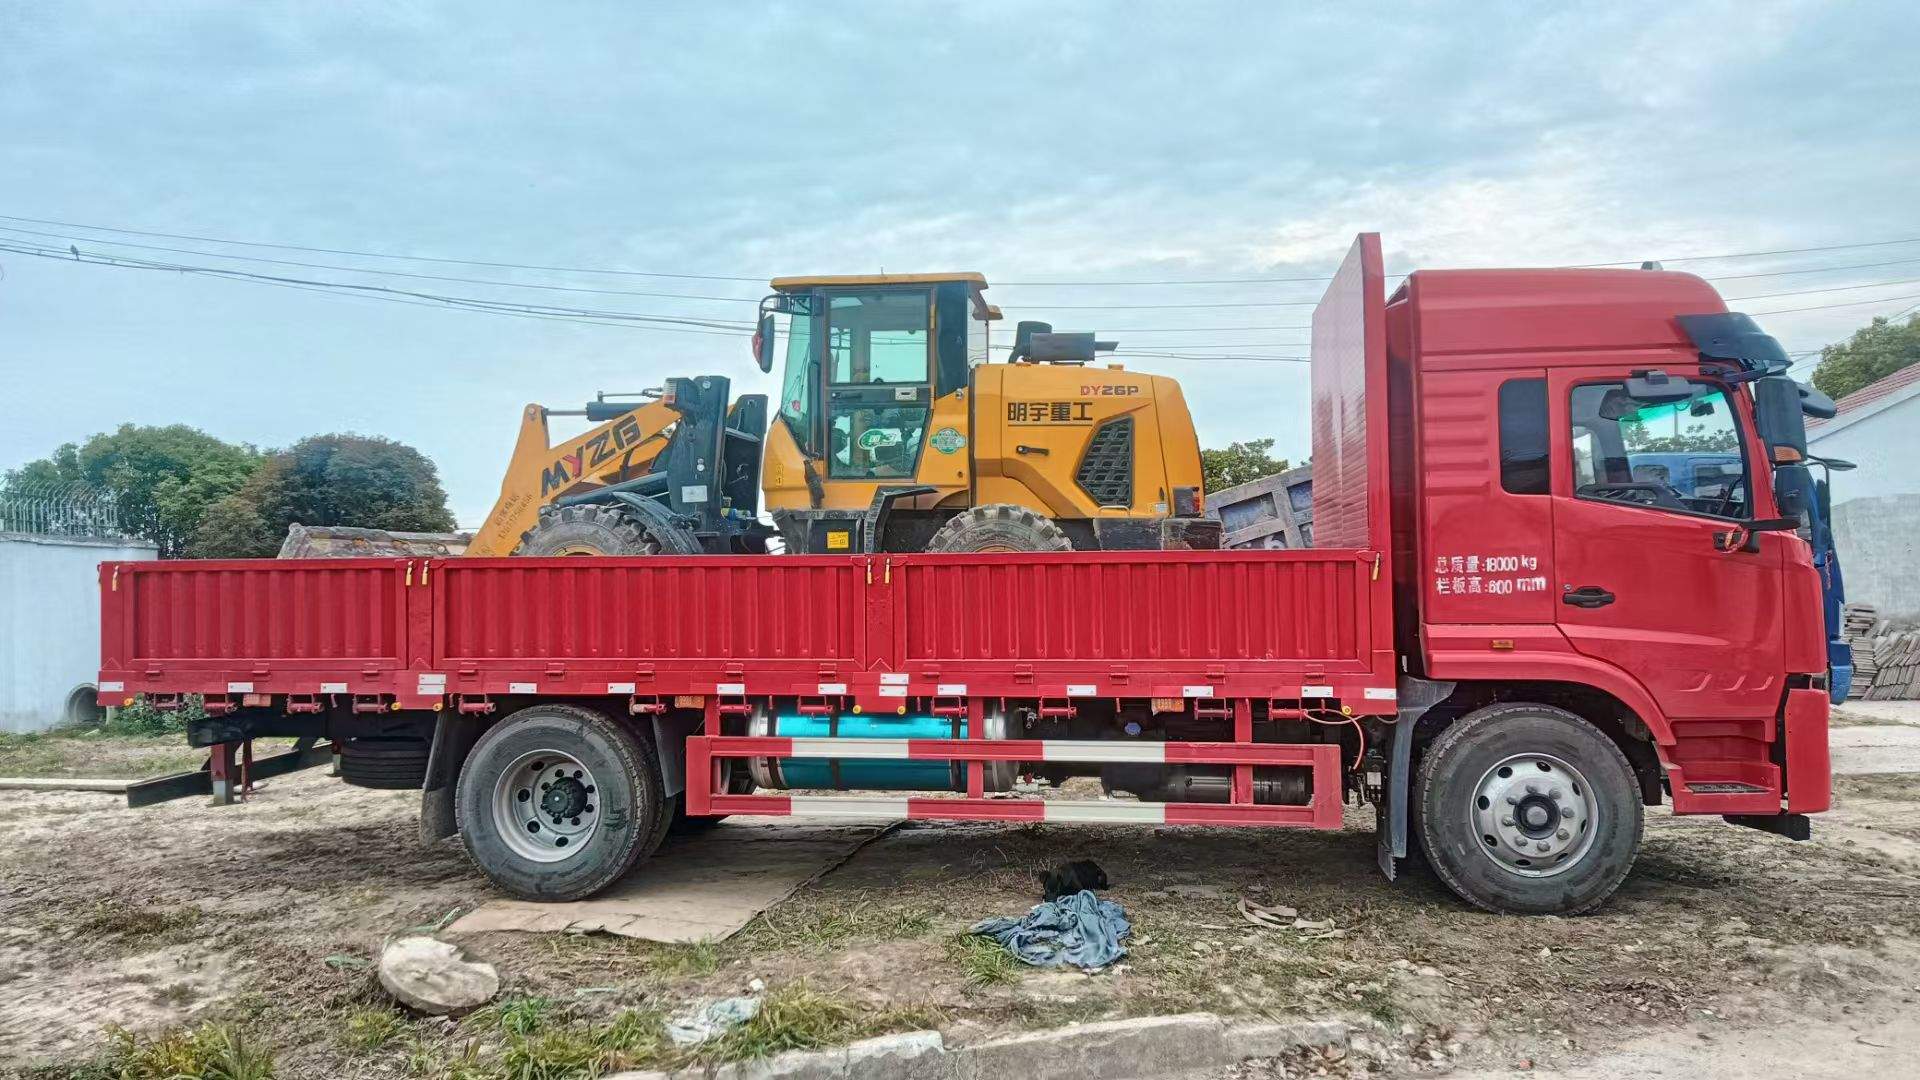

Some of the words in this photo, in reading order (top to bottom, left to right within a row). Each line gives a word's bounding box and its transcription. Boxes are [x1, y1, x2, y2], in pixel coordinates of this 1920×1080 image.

[1080, 385, 1139, 396] DY26P
[1007, 402, 1093, 421] 明宇重工
[541, 415, 641, 498] MYZG
[1521, 555, 1537, 570] kg
[1517, 576, 1546, 591] mm
